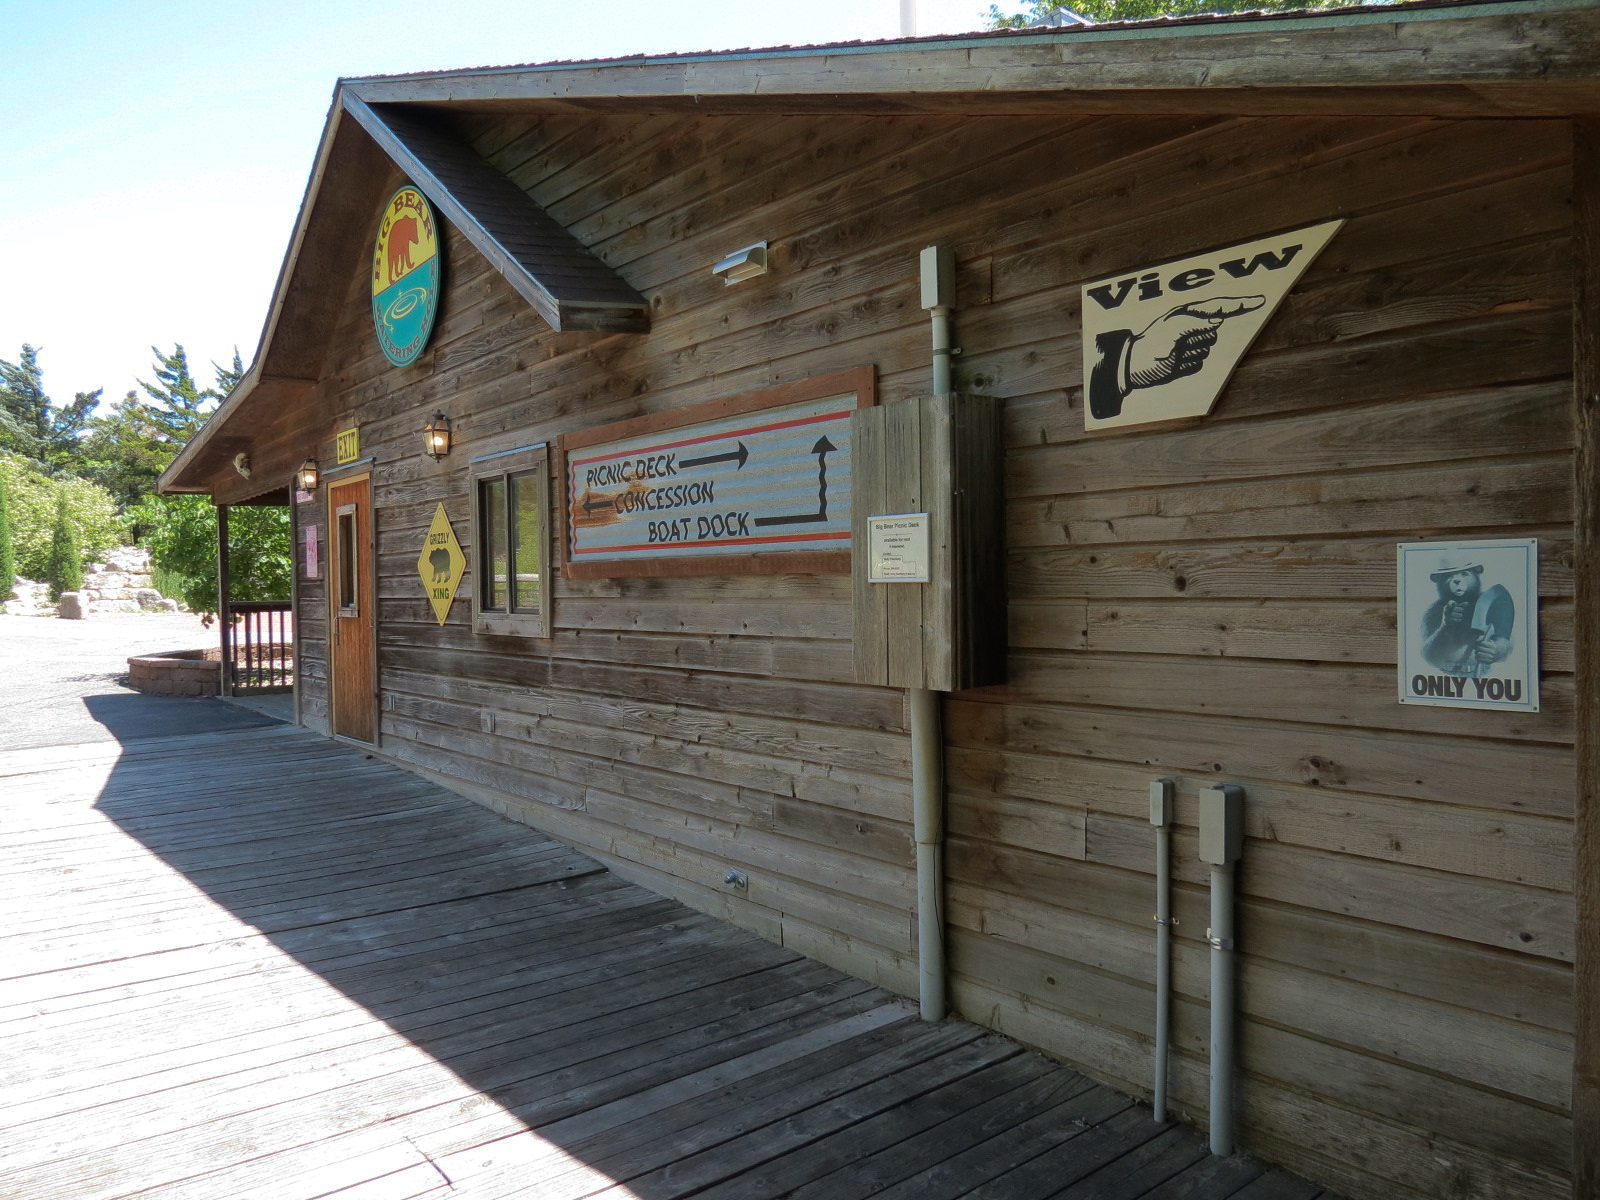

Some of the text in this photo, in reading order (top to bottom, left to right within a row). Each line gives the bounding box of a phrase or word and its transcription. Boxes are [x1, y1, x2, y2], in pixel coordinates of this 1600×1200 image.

[374, 193, 433, 281] BIG BEAR
[1086, 243, 1303, 310] View
[376, 303, 421, 357] WATERING
[338, 431, 357, 460] EXIT
[586, 453, 677, 487] PICNIC DECK
[614, 480, 714, 514] CONCESSION
[429, 532, 450, 545] GRIZZLY
[648, 511, 750, 543] BOAT DOCK
[432, 588, 450, 600] XING
[1411, 674, 1522, 701] ONLY YOU
